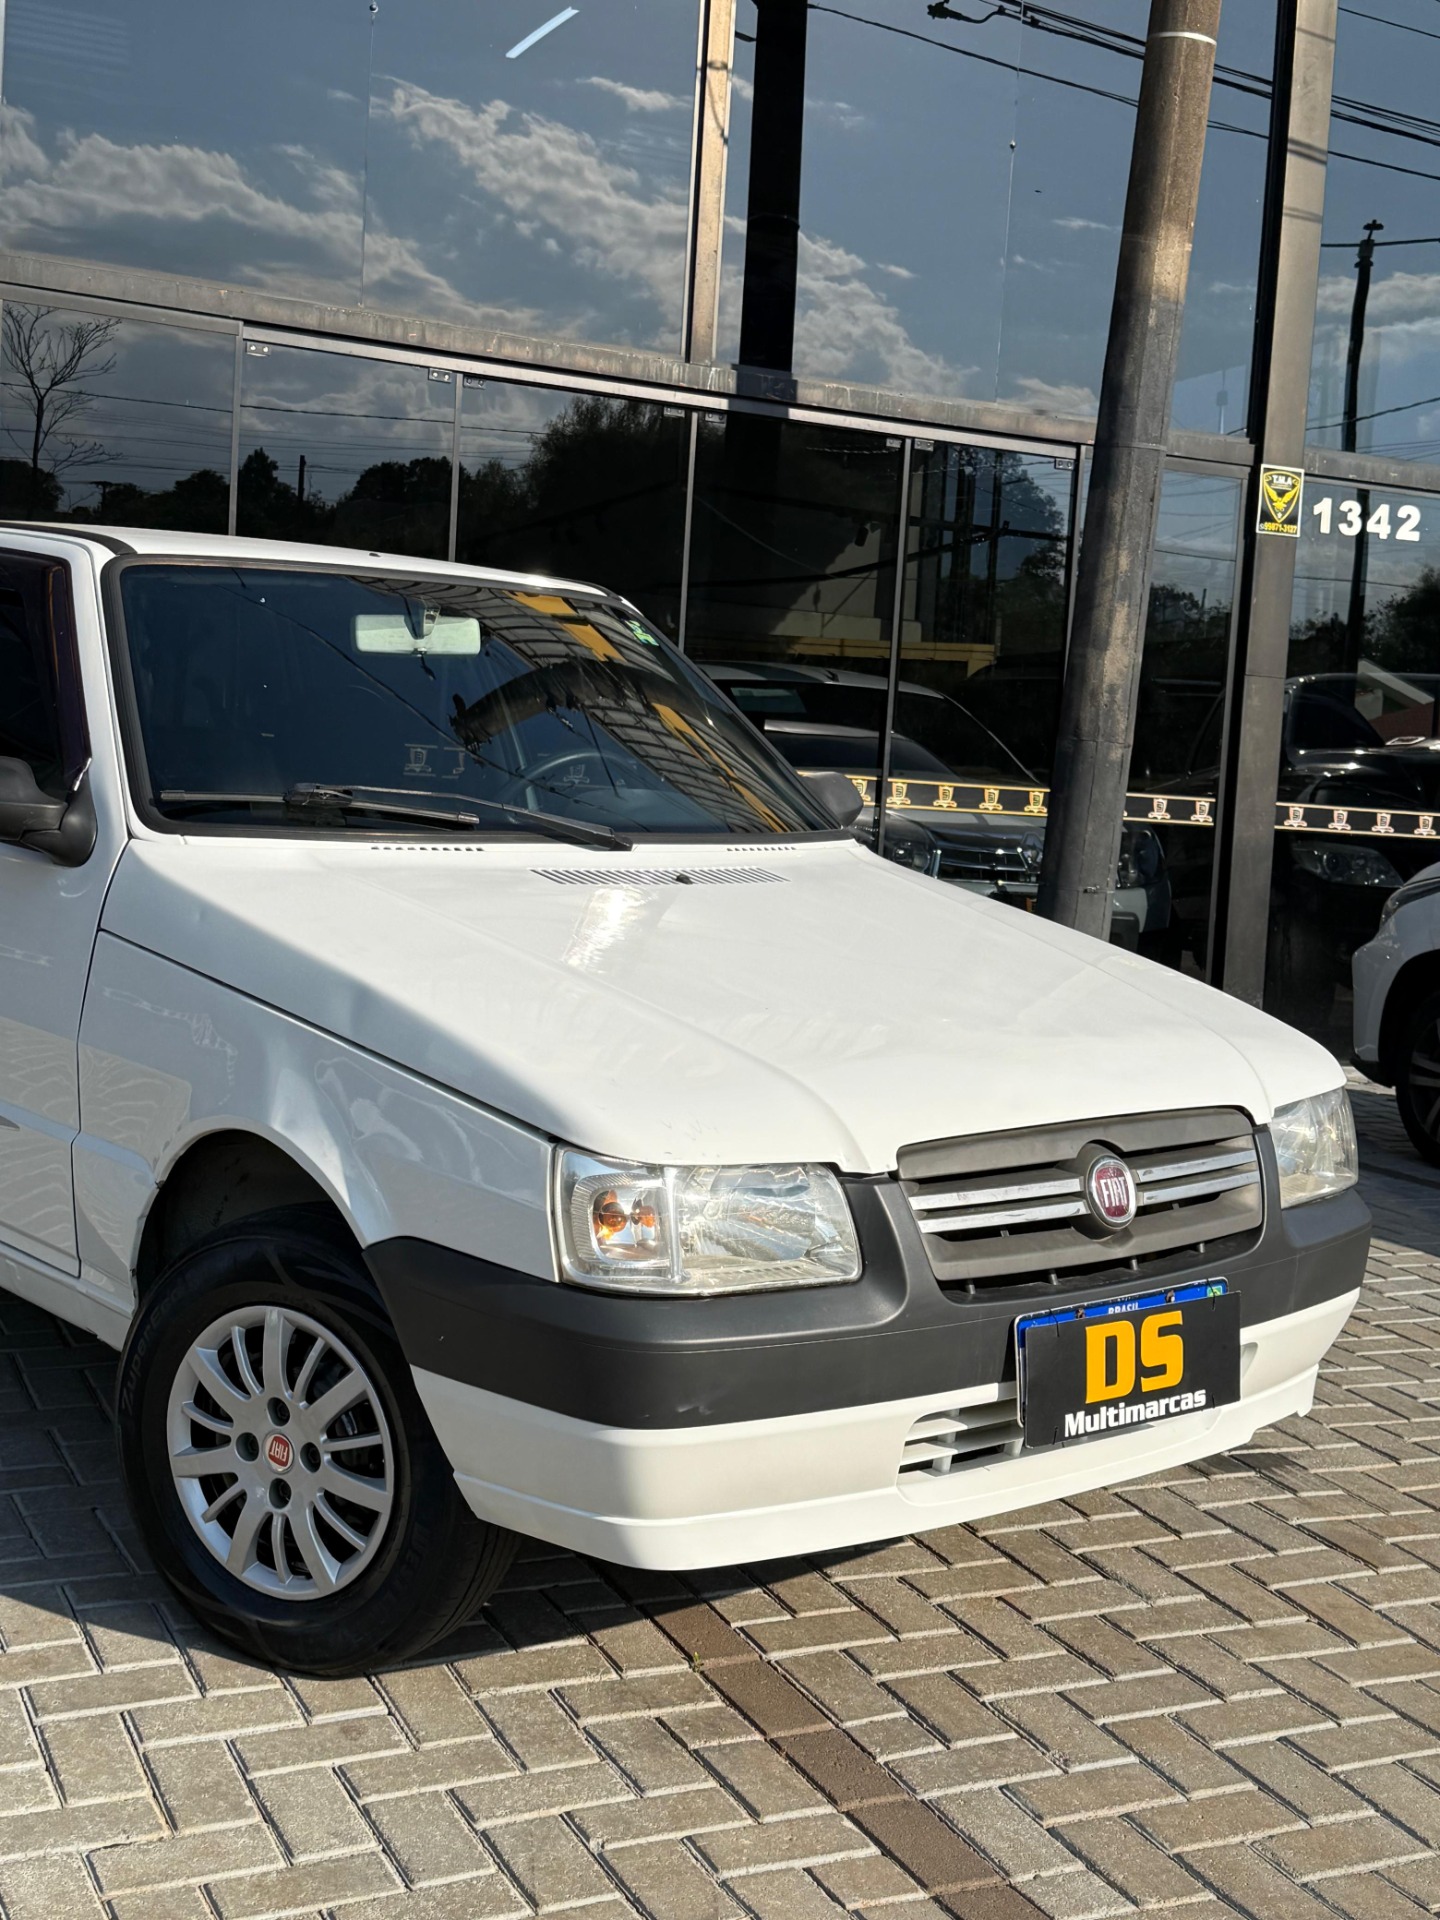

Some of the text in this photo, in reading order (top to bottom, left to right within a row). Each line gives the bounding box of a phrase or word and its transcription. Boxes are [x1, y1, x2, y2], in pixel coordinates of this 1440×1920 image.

[1313, 497, 1421, 542] 1342
[1100, 1176, 1127, 1208] FIAT
[1085, 1310, 1184, 1404] DS
[1064, 1389, 1207, 1438] Multimarcas
[270, 1440, 288, 1462] FIAT
